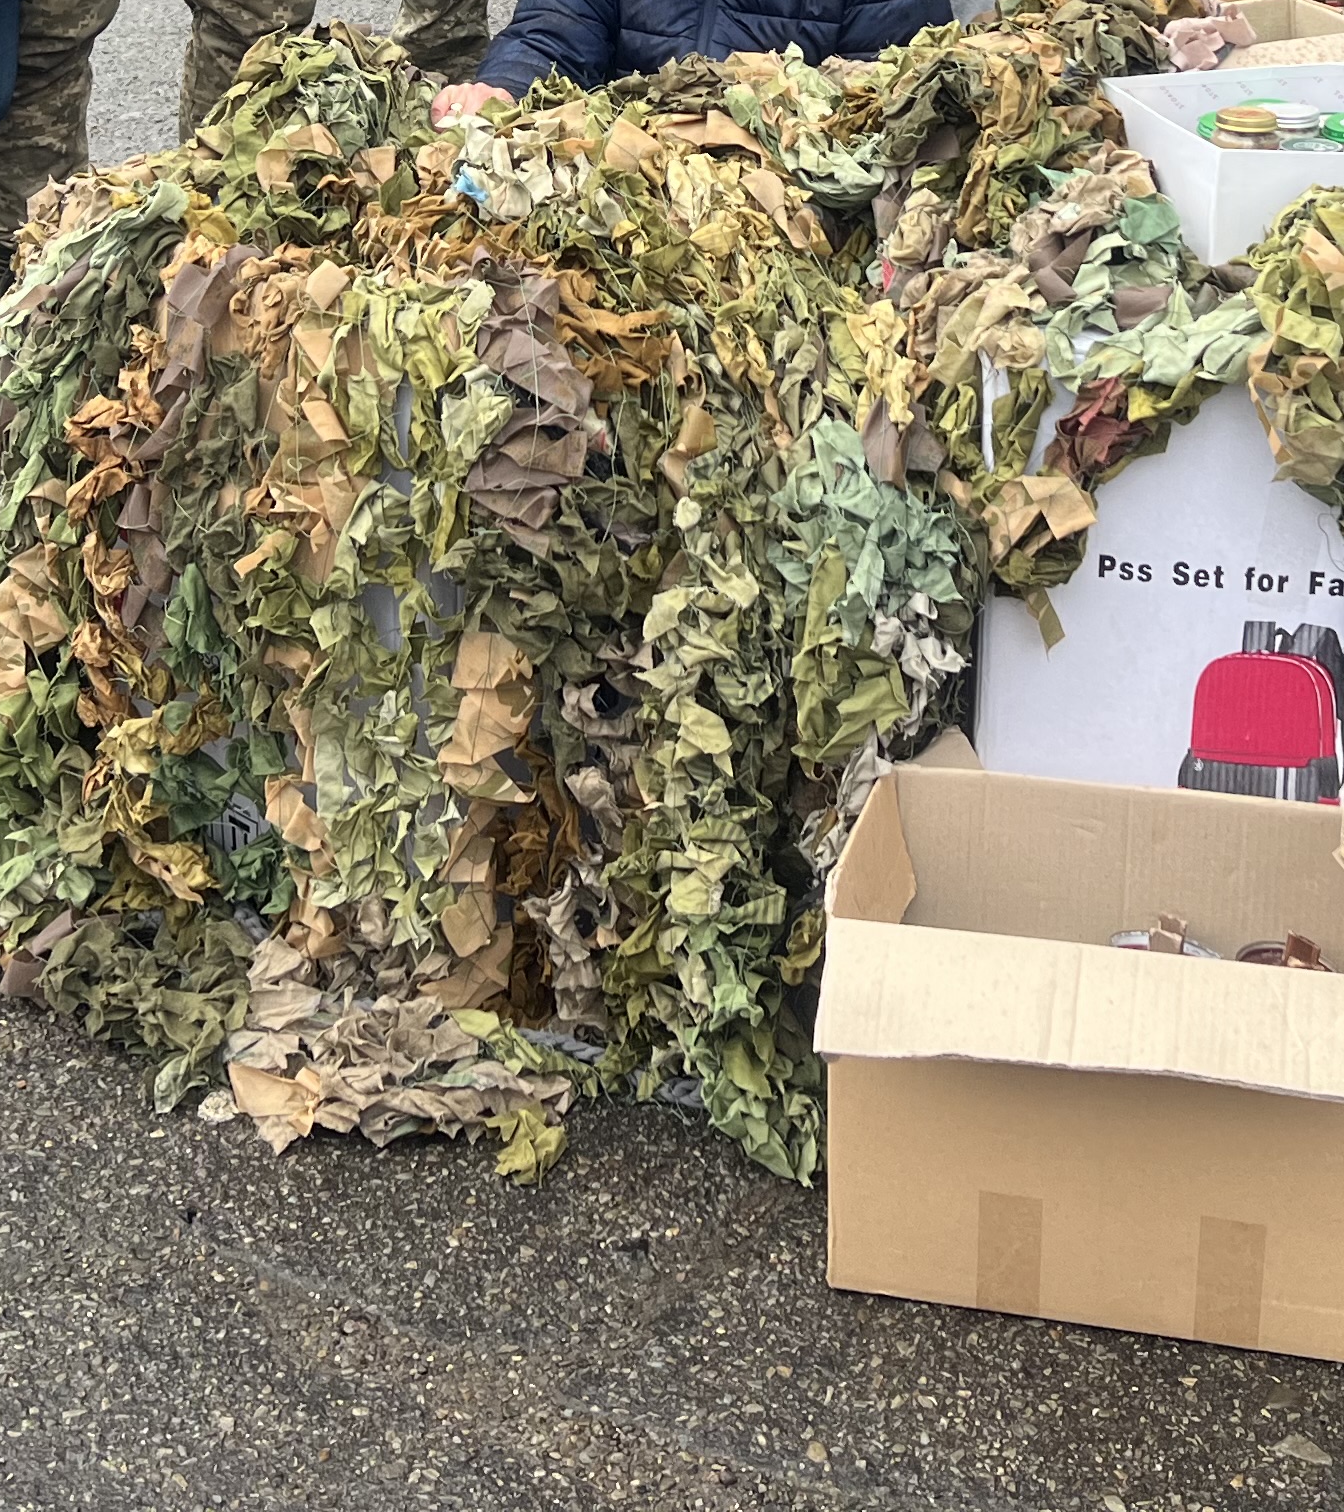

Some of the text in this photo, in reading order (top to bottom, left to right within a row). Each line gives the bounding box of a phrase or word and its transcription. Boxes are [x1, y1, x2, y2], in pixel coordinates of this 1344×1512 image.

[1098, 554, 1152, 582] Pss
[1172, 561, 1224, 589] Set
[1245, 567, 1289, 593] for
